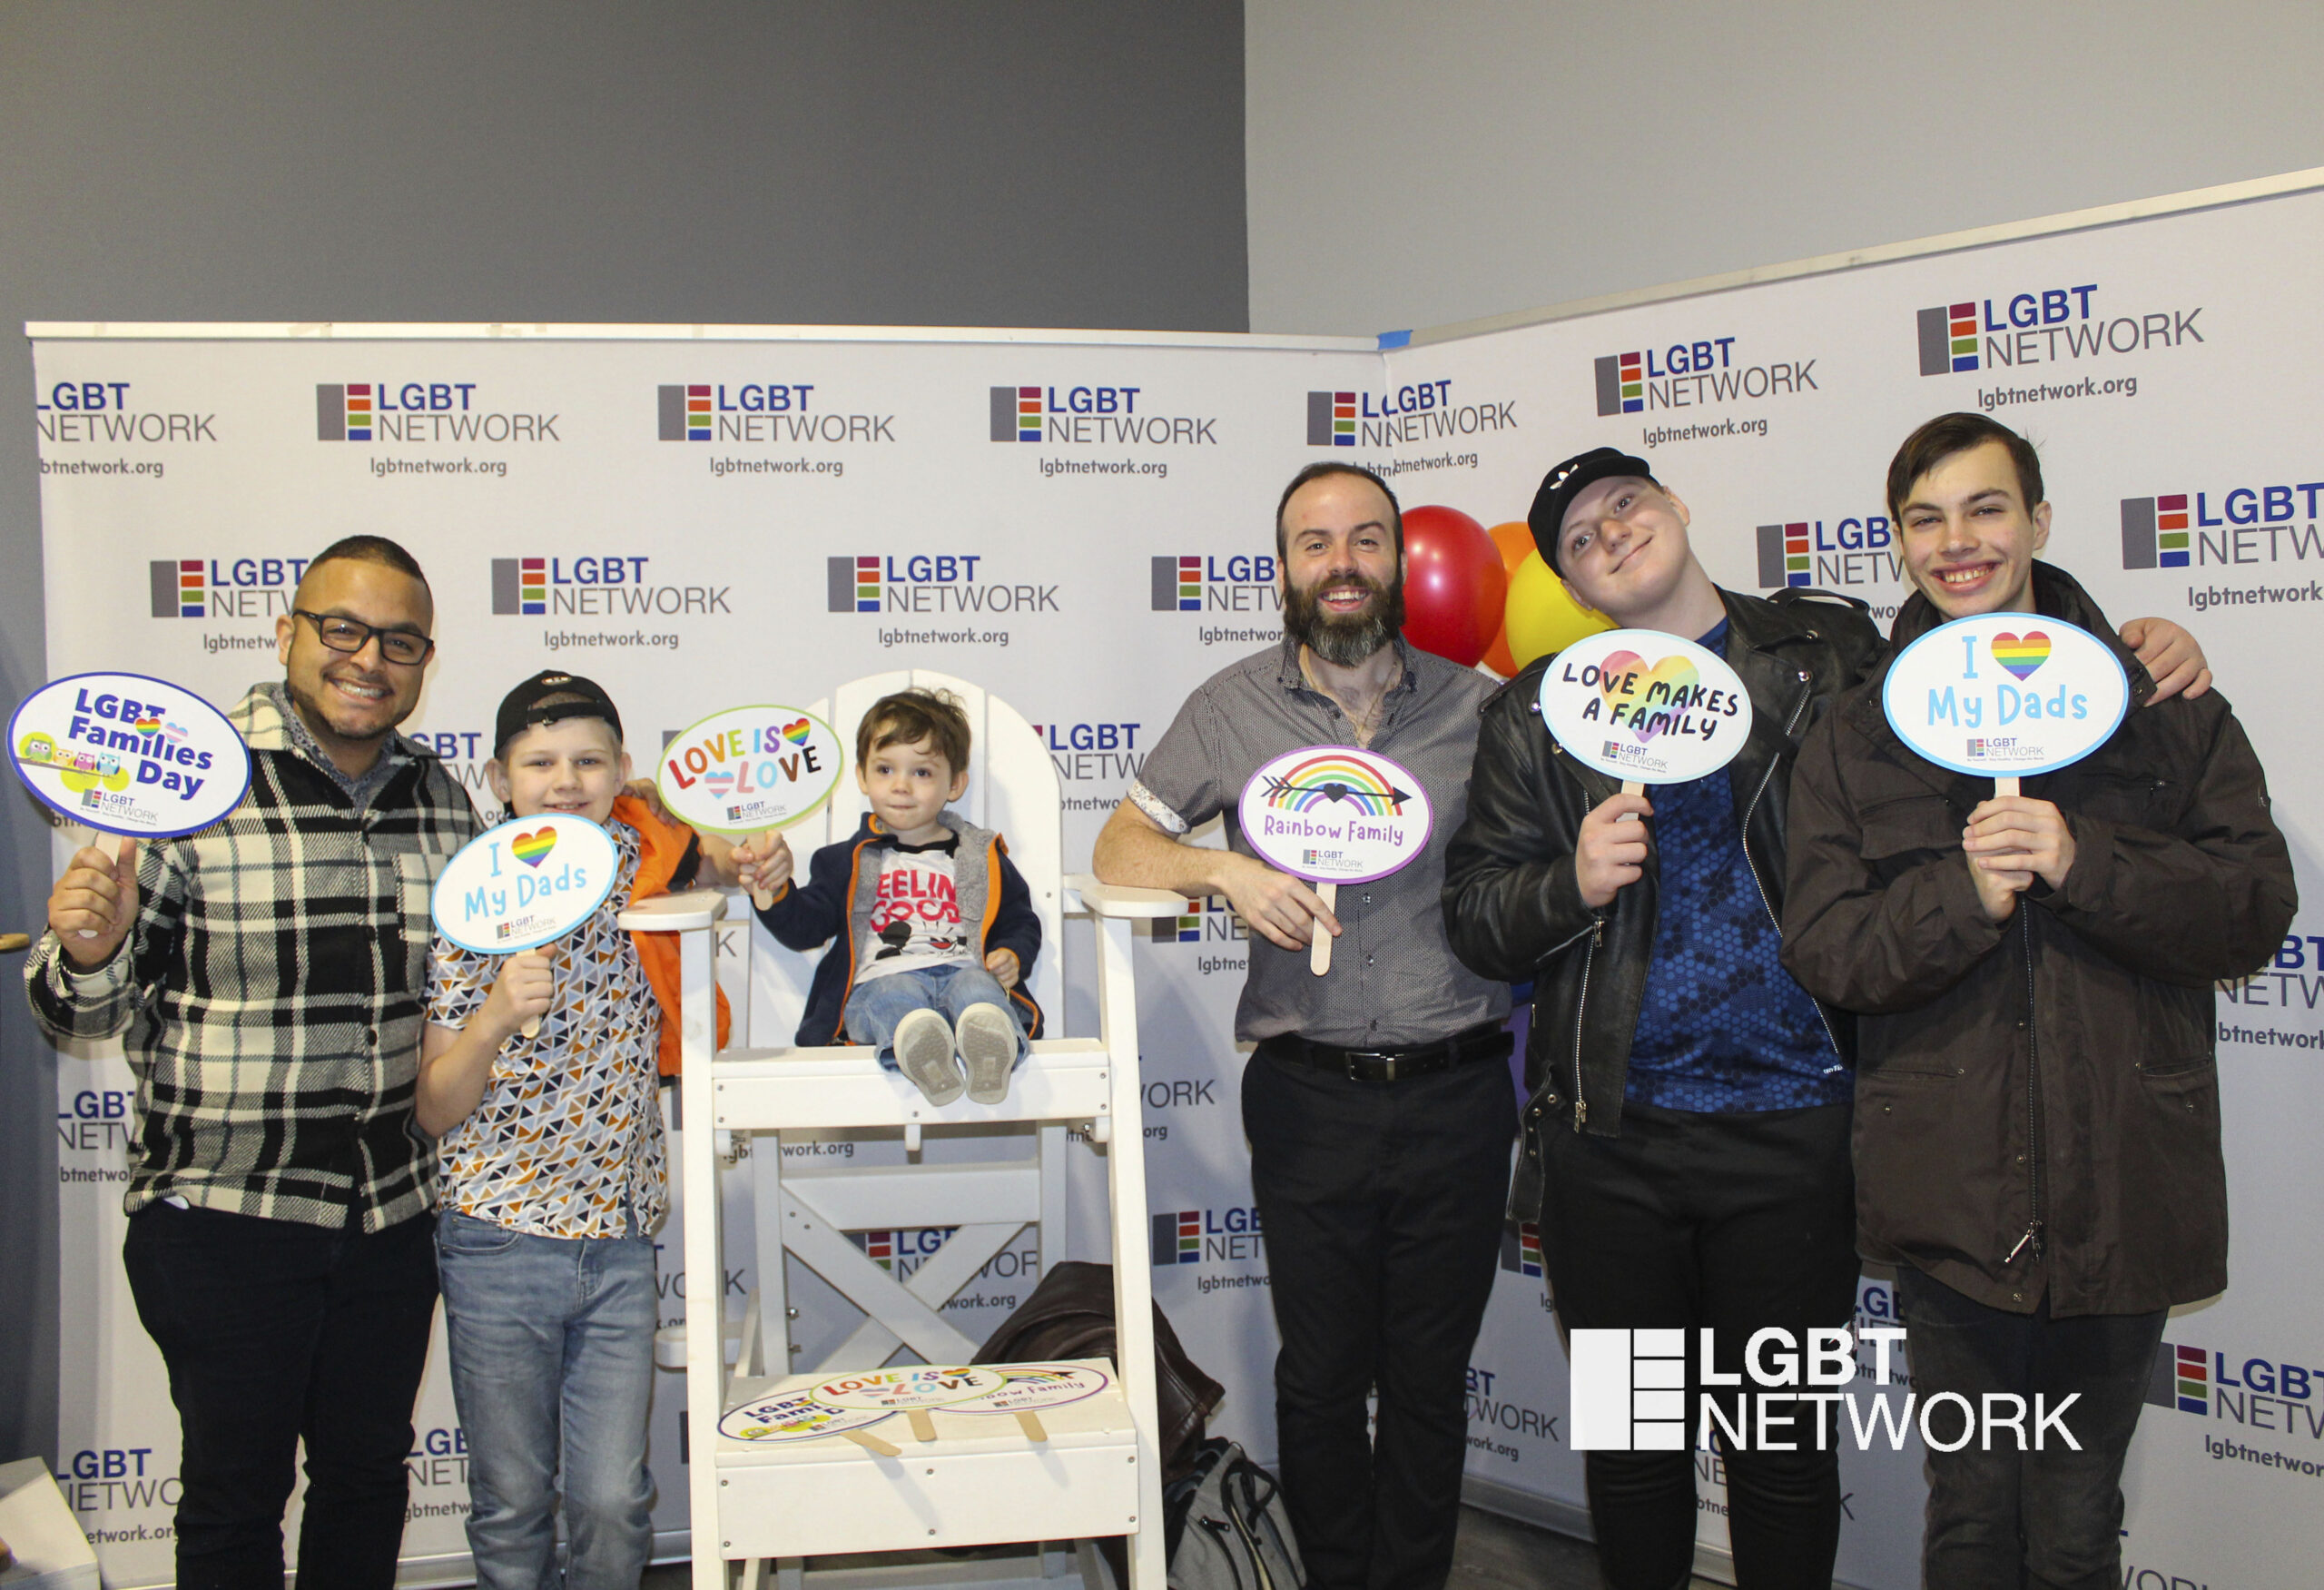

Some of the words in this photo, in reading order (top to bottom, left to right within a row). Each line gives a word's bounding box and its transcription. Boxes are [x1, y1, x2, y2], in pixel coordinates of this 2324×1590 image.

[1984, 284, 2098, 332] LGBT
[1985, 307, 2205, 369] NETWORK
[1647, 338, 1736, 378] LGBT
[378, 383, 477, 410] LGBT
[718, 385, 814, 411] LGBT
[1649, 360, 1819, 410] NETWORK
[1977, 376, 2138, 412] lgbtnetwork.org
[1048, 388, 1140, 413] LGBT
[379, 414, 560, 442] NETWORK
[718, 415, 896, 442] NETWORK
[1048, 417, 1217, 444] NETWORK
[1643, 417, 1768, 448] lgbtnetwork.org
[40, 458, 164, 479] btnetwork.org
[370, 458, 507, 478] lgbtnetwork.org
[710, 457, 843, 477] lgbtnetwork.org
[1039, 458, 1167, 478] lgbtnetwork.org
[1393, 452, 1478, 474] btnetwork.org
[1816, 517, 1891, 551] LGB
[2199, 524, 2324, 566] NETW
[552, 557, 648, 584] LGBT
[887, 556, 980, 582] LGBT
[1207, 556, 1275, 582] LGB
[553, 587, 732, 615] NETWORK
[887, 585, 1059, 612] NETWORK
[545, 630, 679, 651] lgbtnetwork.org
[879, 627, 1009, 647] lgbtnetwork.org
[1962, 636, 1979, 679] I
[1562, 663, 1639, 695] LOVE
[1646, 681, 1738, 716] MAKES
[74, 687, 166, 725] LGBT
[1582, 697, 1600, 721] A
[1610, 704, 1718, 741] FAMILY
[1927, 686, 1983, 729] My
[1996, 684, 2088, 726] Dads
[68, 716, 213, 770] Families
[1050, 724, 1140, 750] LGBT
[1620, 743, 1648, 755] LGBT
[1985, 737, 2017, 747] LGBT
[668, 728, 746, 790] LOVE
[753, 726, 781, 754] IS
[1618, 752, 1669, 769] NETWORK
[1985, 746, 2044, 756] NETWORK
[136, 759, 205, 801] Day
[737, 746, 822, 794] LOVE
[101, 802, 159, 822] NETWORK
[103, 793, 135, 806] LGBT
[741, 801, 765, 812] LGBT
[742, 805, 786, 820] NETWORK
[1264, 815, 1342, 839] Rainbow
[1348, 821, 1403, 846] Family
[488, 842, 502, 877] I
[1317, 858, 1364, 868] NETWORK
[1318, 850, 1344, 859] LGBT
[466, 886, 507, 922] My
[517, 864, 586, 908] Dads
[822, 1373, 903, 1396] LOVE
[911, 1371, 940, 1382] IS
[892, 1376, 983, 1396] LOVE
[1027, 1382, 1086, 1394] Family
